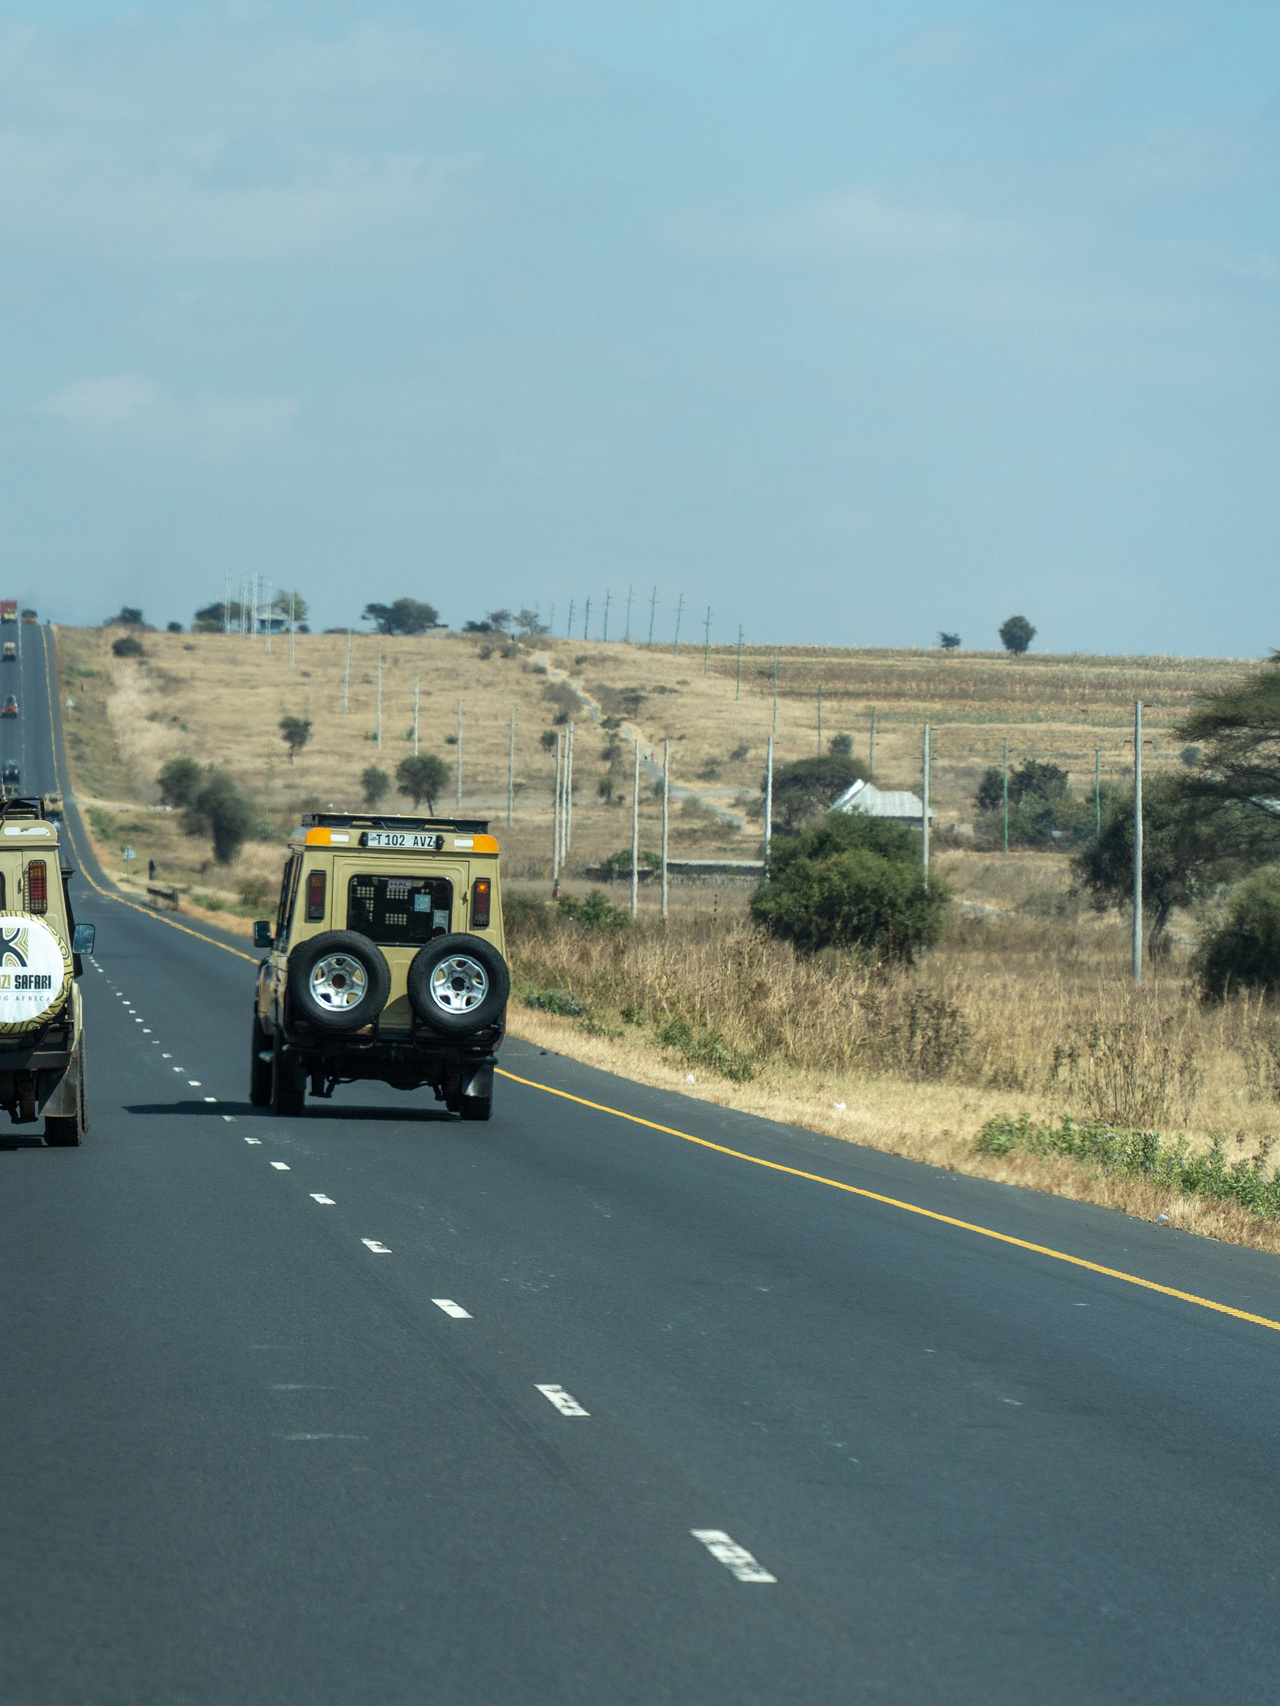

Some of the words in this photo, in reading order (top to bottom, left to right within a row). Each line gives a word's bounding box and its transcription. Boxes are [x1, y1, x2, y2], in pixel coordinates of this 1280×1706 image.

[376, 834, 382, 845] T
[385, 834, 405, 846] 102
[413, 836, 433, 847] AVZ
[14, 974, 52, 990] SAFARI
